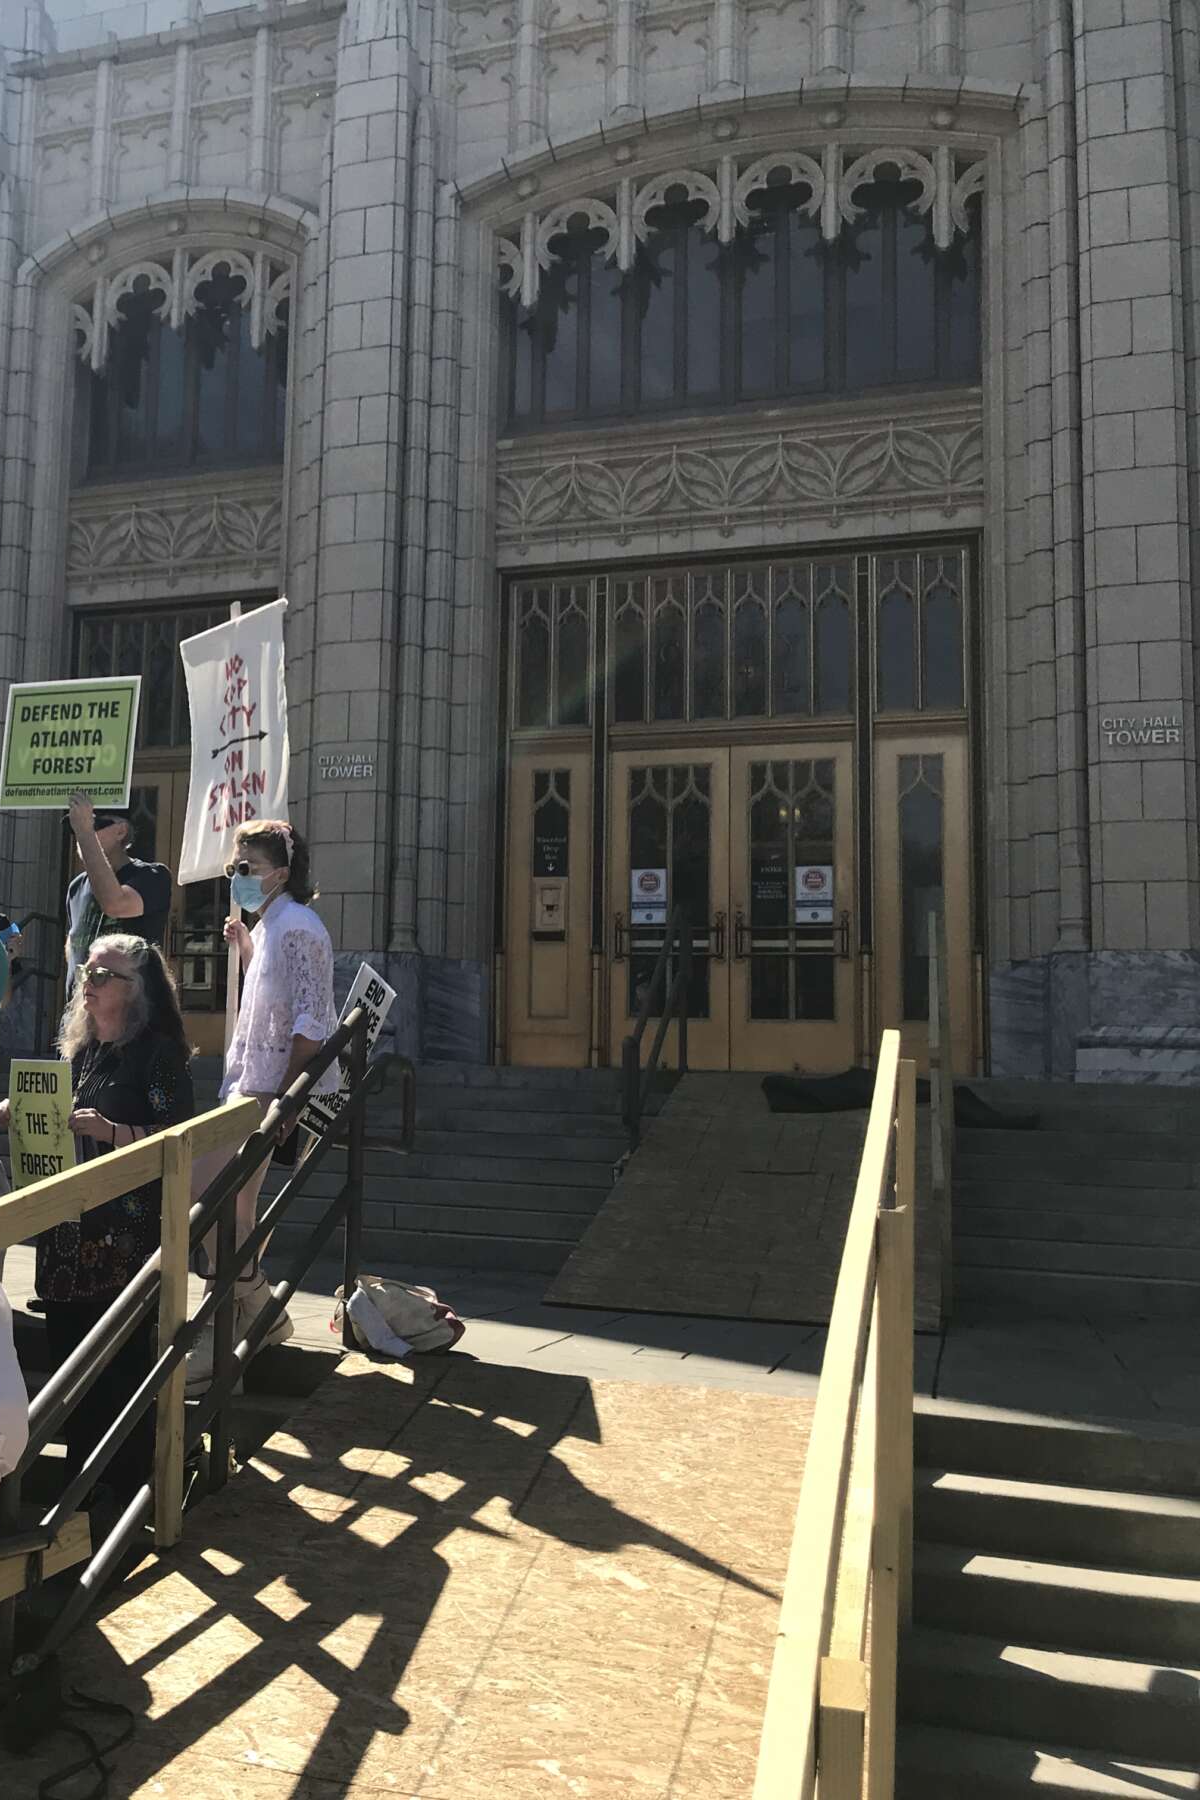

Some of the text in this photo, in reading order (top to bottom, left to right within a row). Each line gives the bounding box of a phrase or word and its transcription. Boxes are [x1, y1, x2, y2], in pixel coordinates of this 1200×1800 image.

[225, 654, 244, 681] NO
[20, 701, 120, 722] DEFEND THE
[1102, 715, 1180, 729] CITY HALL
[30, 729, 103, 748] ATLANTA
[1104, 729, 1180, 745] TOWER
[32, 756, 96, 775] FOREST
[224, 750, 243, 775] ON
[319, 753, 372, 765] CITY HALL
[321, 764, 373, 779] TOWER
[364, 978, 386, 1008] END
[17, 1071, 58, 1094] DEFEND
[25, 1112, 49, 1135] THE
[21, 1153, 63, 1177] FOREST
